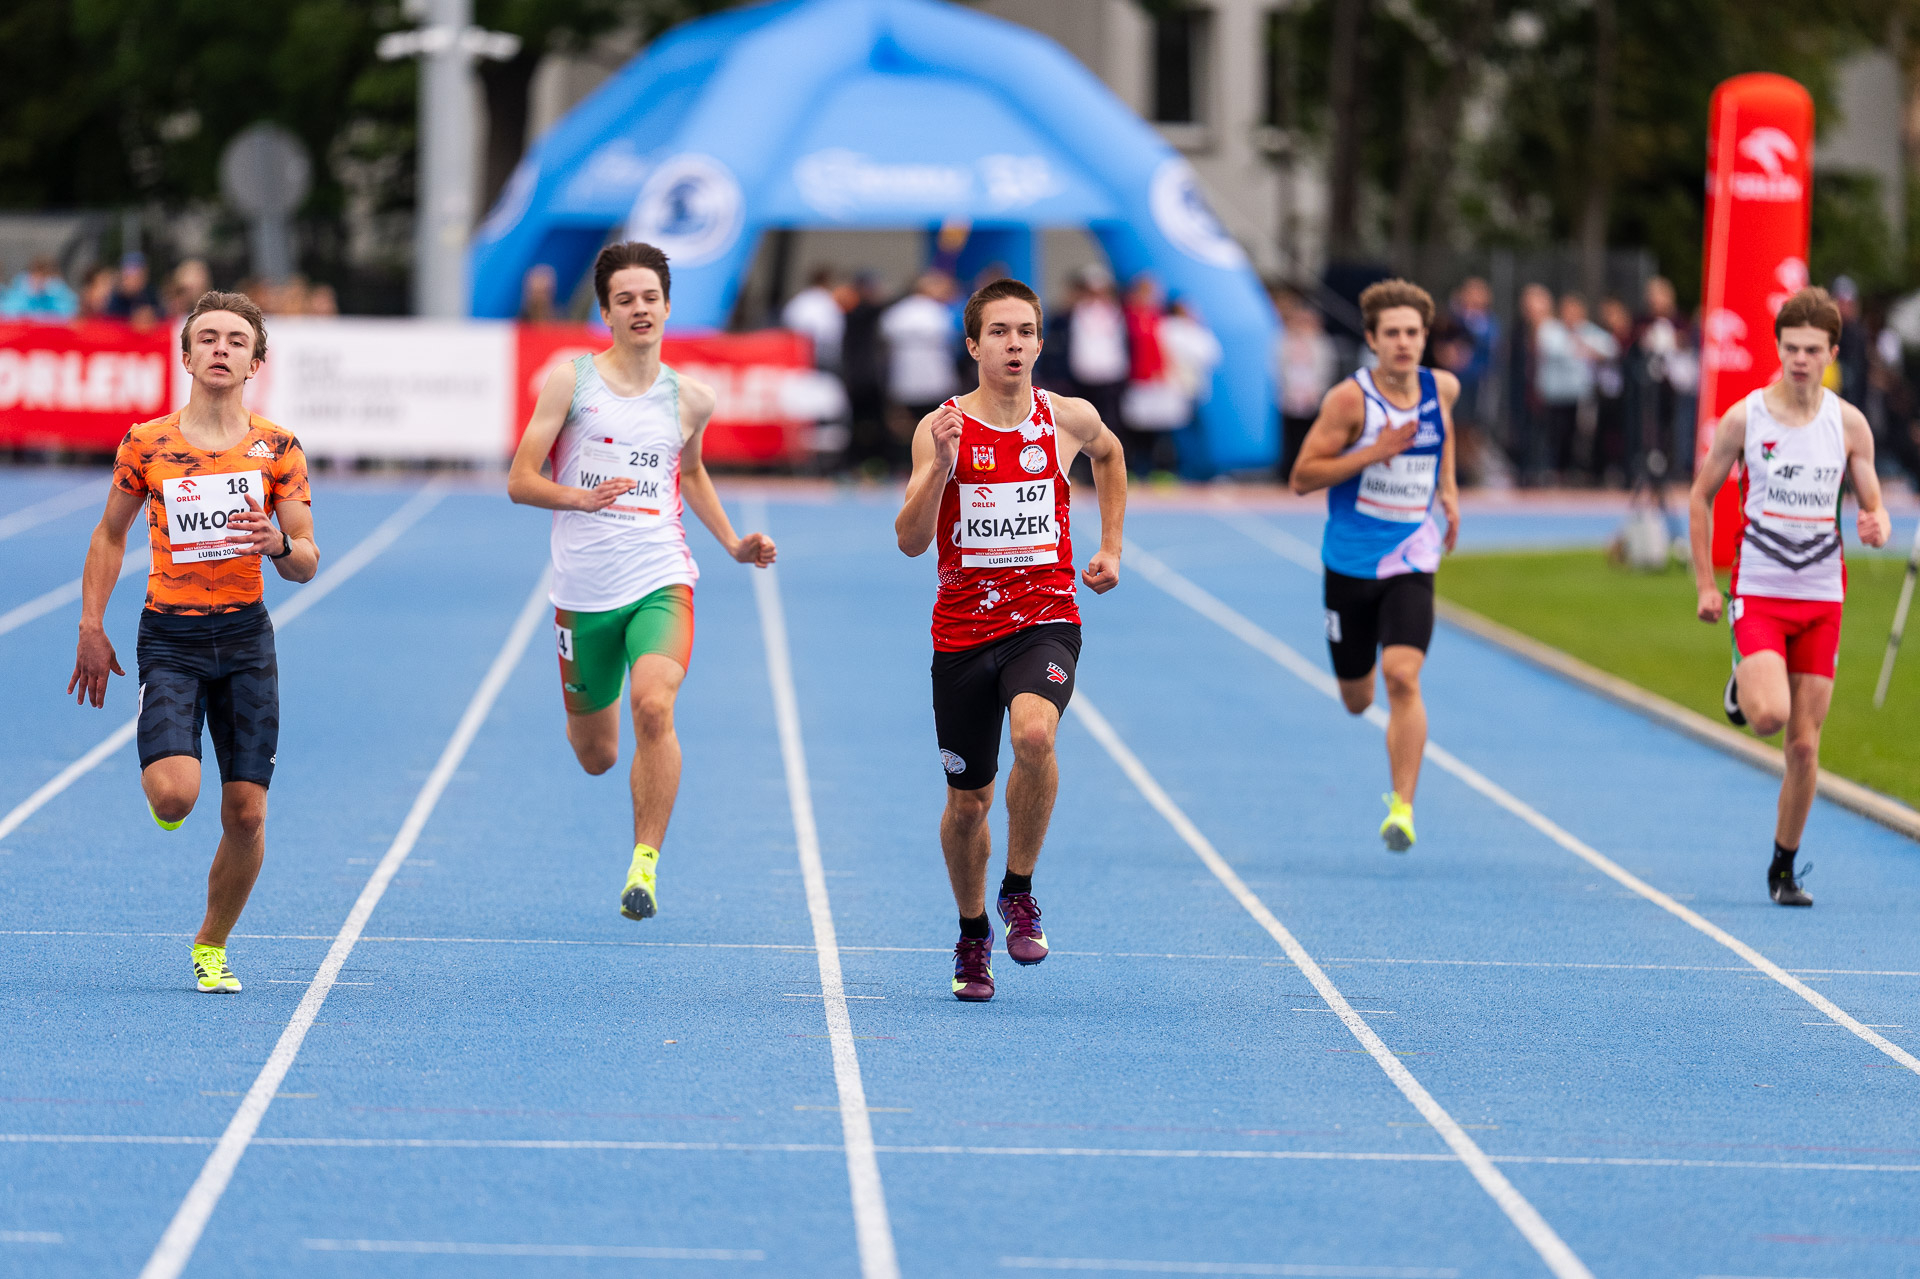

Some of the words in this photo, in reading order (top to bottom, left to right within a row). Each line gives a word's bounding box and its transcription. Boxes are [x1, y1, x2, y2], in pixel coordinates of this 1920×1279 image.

[248, 450, 275, 459] adidas
[629, 452, 659, 467] 258
[1813, 467, 1839, 481] 377
[226, 478, 249, 495] 18
[176, 495, 201, 503] ORLEN
[1015, 485, 1047, 503] 167
[967, 512, 1050, 540] KSIĄŻEK
[223, 547, 239, 556] 202
[988, 557, 1012, 565] LUBIN
[1013, 555, 1034, 563] 2026
[559, 630, 568, 655] 4
